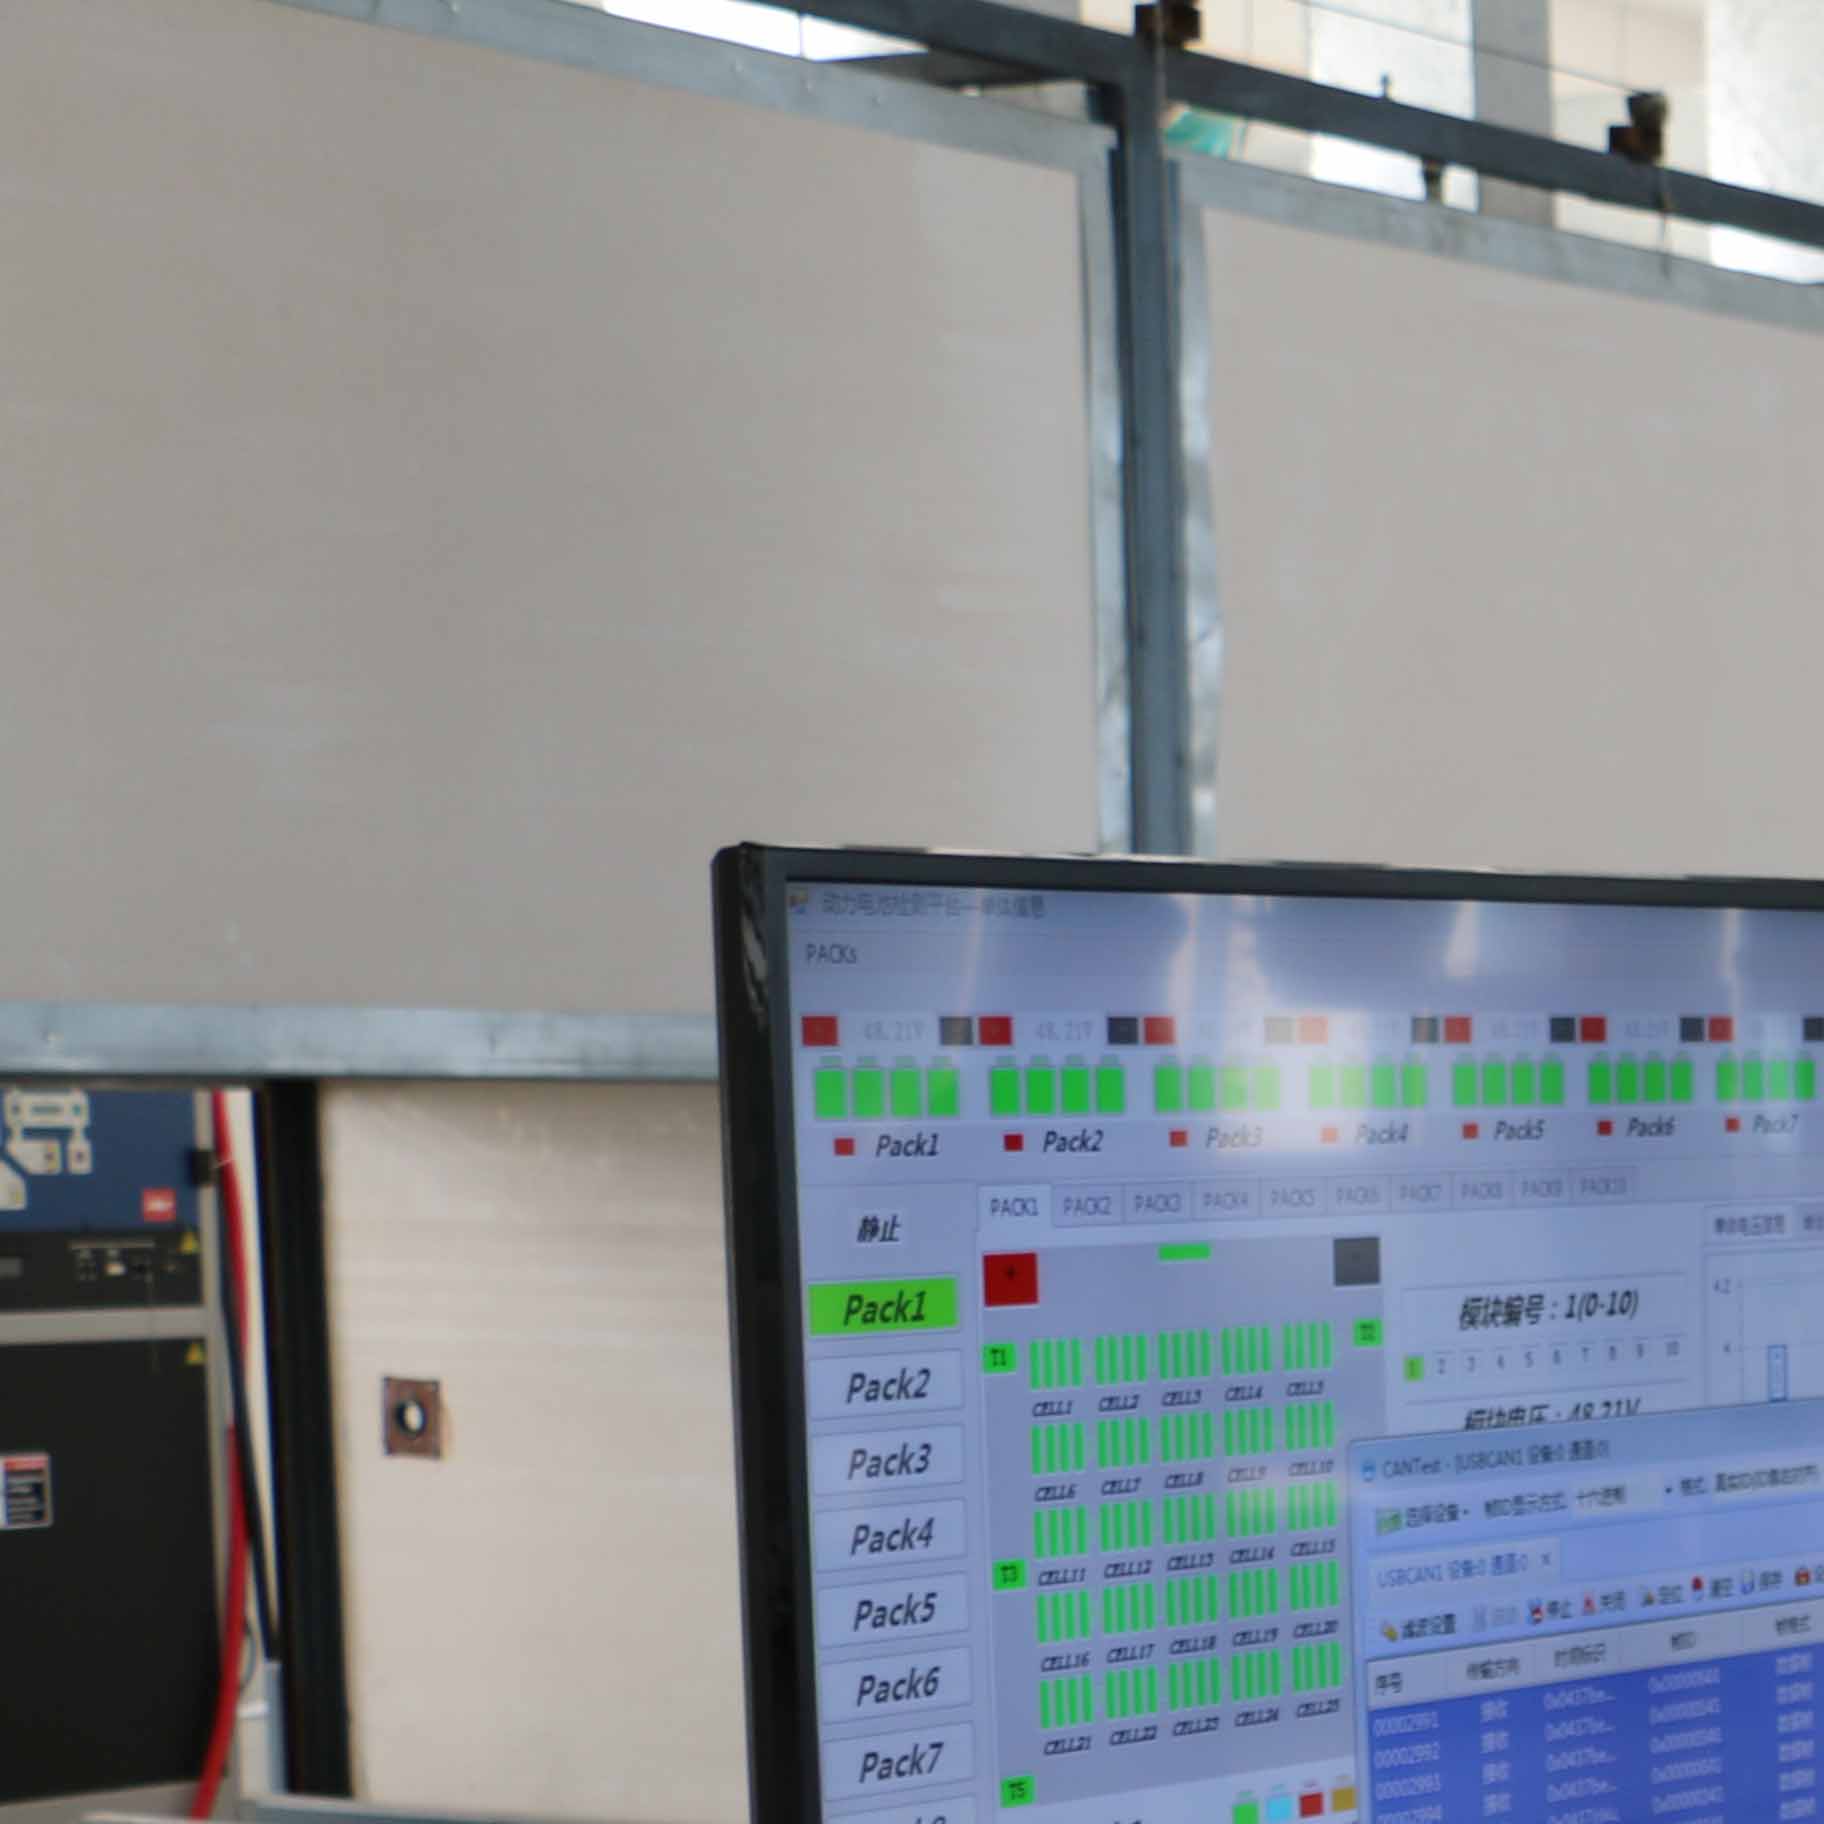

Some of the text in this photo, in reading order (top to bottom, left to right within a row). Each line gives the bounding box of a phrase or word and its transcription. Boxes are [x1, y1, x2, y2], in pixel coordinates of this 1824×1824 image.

[875, 1132, 940, 1158] Pack1
[1043, 1129, 1103, 1154] Pack2
[843, 1290, 926, 1326] Pack1
[846, 1367, 931, 1404] Pack2
[848, 1443, 932, 1480] Pack3
[850, 1516, 934, 1556] Pack4
[853, 1591, 937, 1631] Pack5
[856, 1665, 940, 1706] Pack6
[859, 1741, 944, 1783] Pack7
